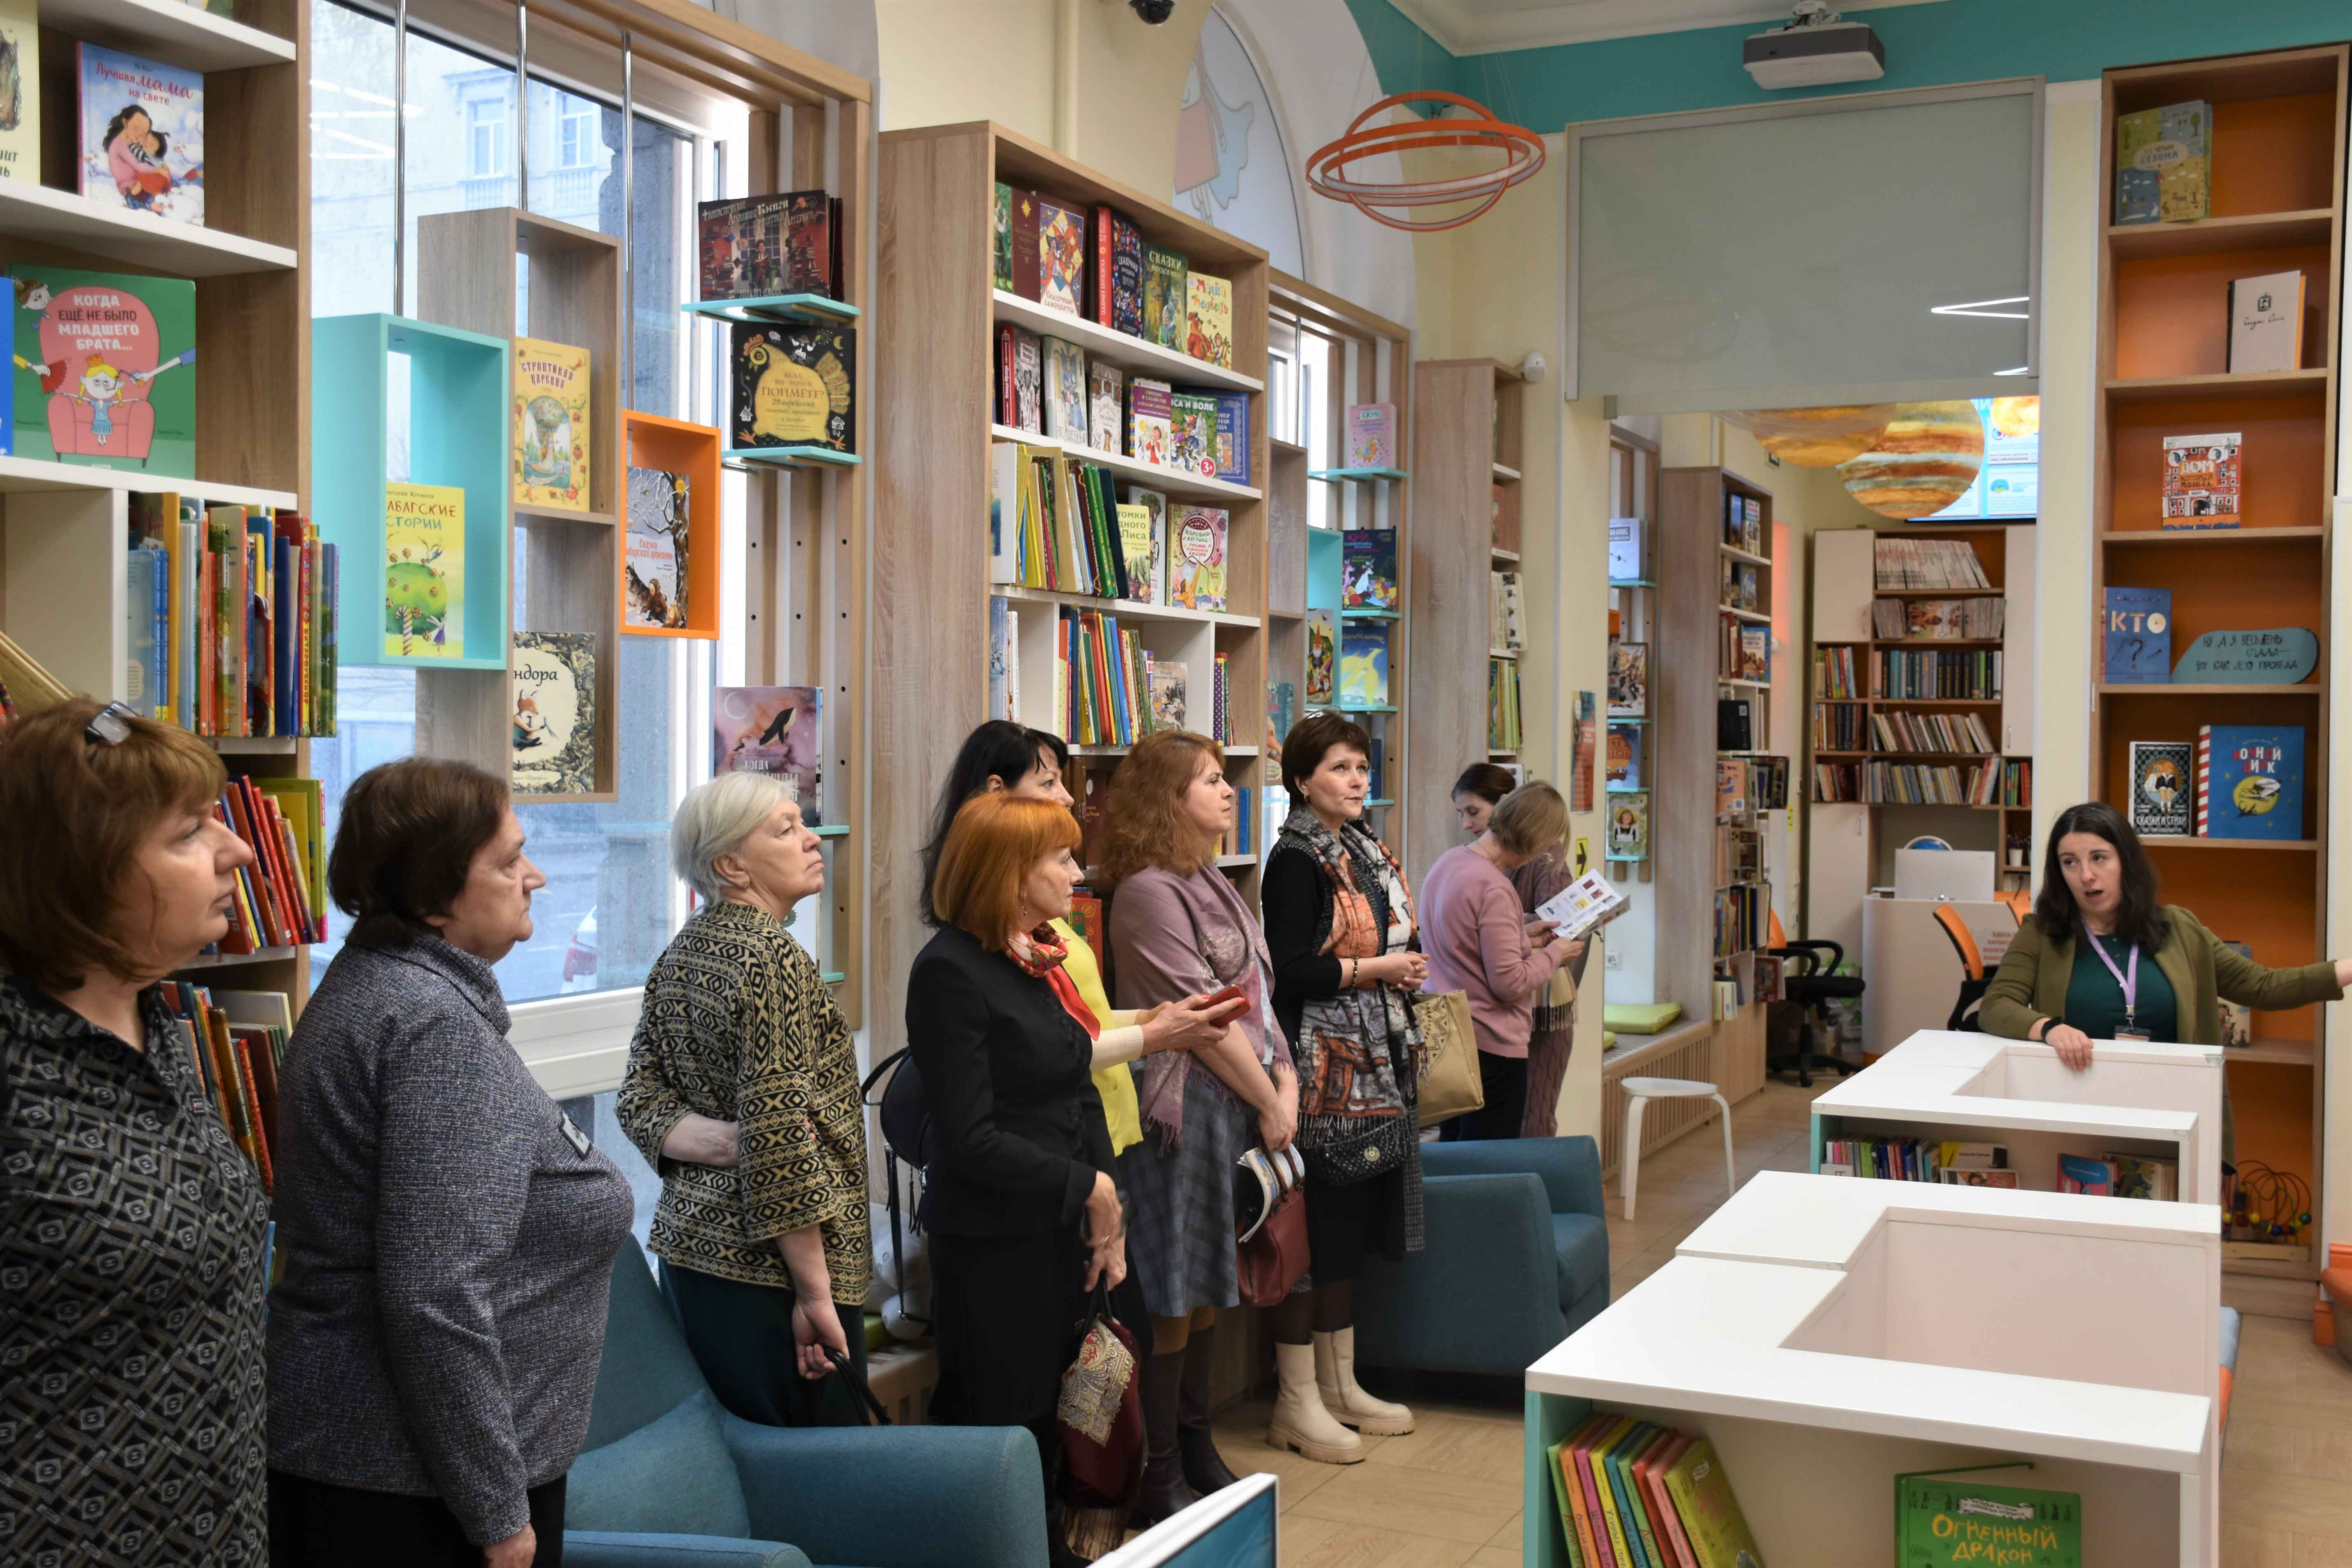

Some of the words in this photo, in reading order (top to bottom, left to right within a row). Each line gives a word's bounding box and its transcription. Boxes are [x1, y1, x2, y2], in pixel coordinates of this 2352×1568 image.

[96, 62, 135, 82] Лучшая
[136, 75, 194, 98] мама
[129, 88, 140, 98] на
[143, 92, 170, 105] свете
[2140, 150, 2179, 164] СЕЗОНА
[1149, 251, 1182, 270] СКАЗКИ
[74, 294, 120, 308] КОГДА
[59, 308, 84, 322] ЕЩЁ
[87, 310, 102, 320] НЕ
[105, 310, 137, 321] БЫЛО
[59, 324, 139, 337] МЛАДШЕГО
[1194, 402, 1214, 411] ВОЛК
[1203, 461, 1213, 473] 3+
[2181, 460, 2214, 474] ДОМ
[387, 500, 456, 517] АБАГСКИЕ
[1117, 511, 1146, 519] томки
[386, 516, 441, 530] СТОРИИ
[1119, 521, 1146, 529] дного
[1121, 530, 1146, 540] Лиса
[2111, 610, 2166, 634] КТО
[514, 664, 559, 687] ндора
[2233, 746, 2281, 761] НОЧНОЙ
[745, 760, 768, 770] КОГДА
[2243, 758, 2275, 773] ЦИРК
[1615, 1549, 1627, 1568] ГОНК
[1952, 1541, 2033, 1566] ДРАКОН
